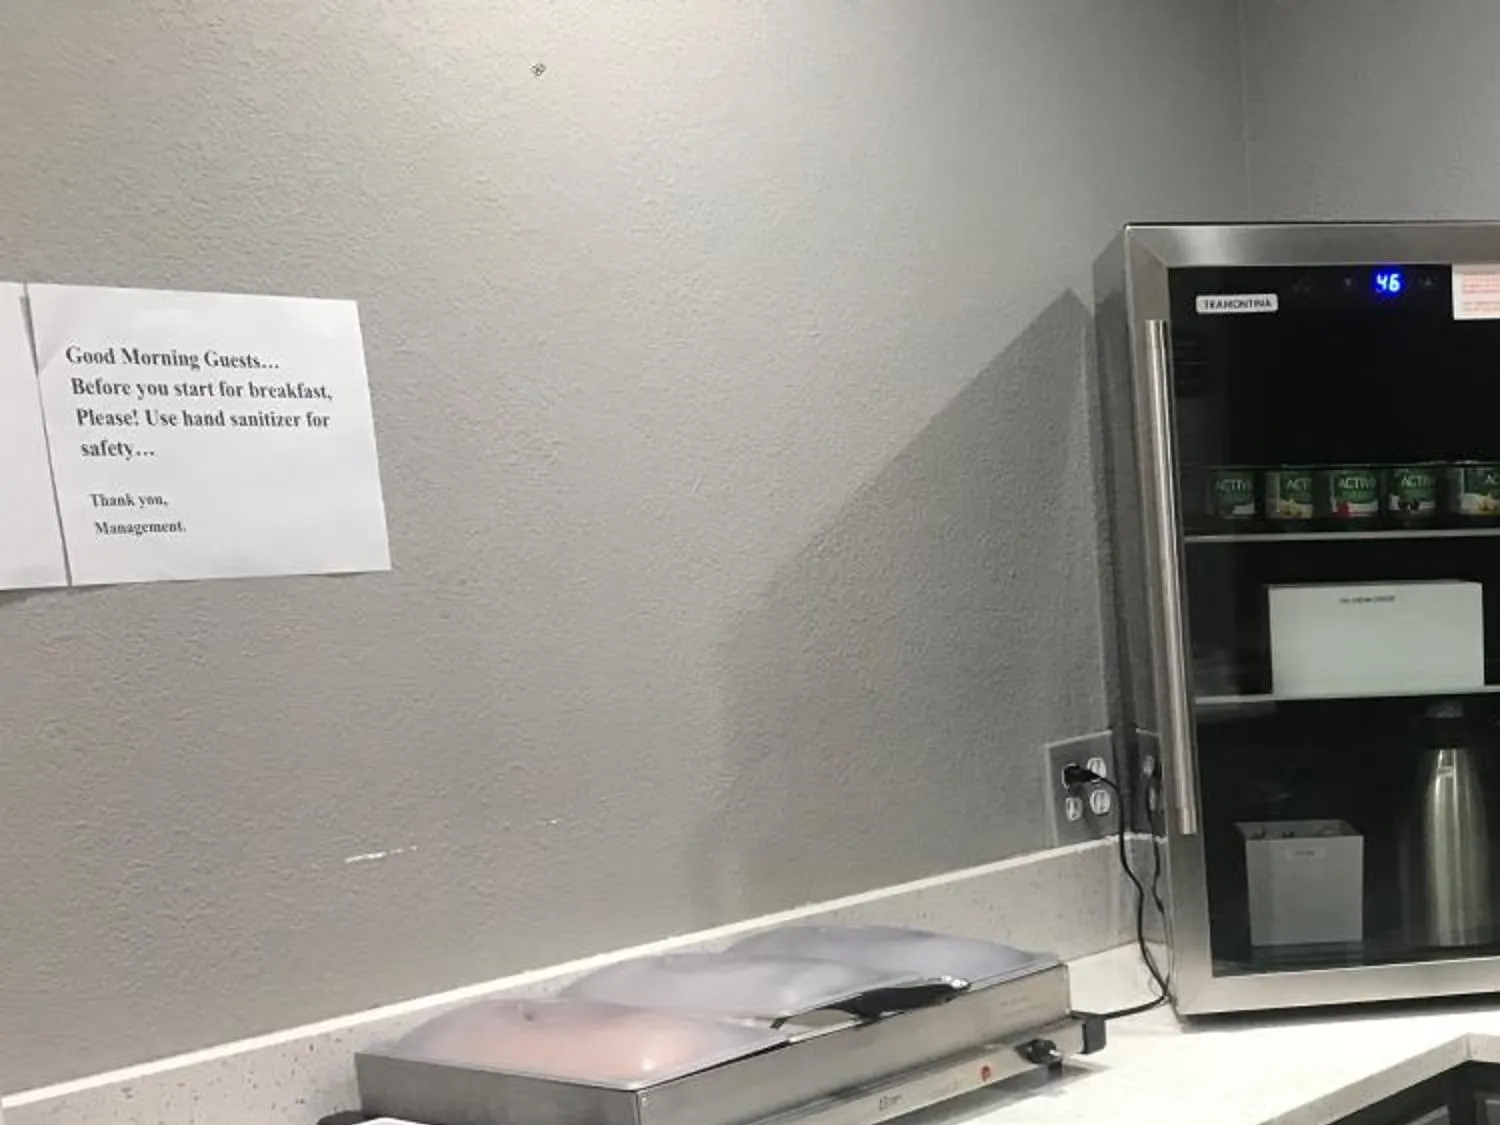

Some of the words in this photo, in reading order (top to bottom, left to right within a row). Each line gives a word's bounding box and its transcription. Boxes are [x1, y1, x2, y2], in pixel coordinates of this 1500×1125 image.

[1376, 272, 1400, 293] 46
[65, 346, 116, 365] Good
[121, 347, 200, 369] Morning
[204, 350, 279, 369] Guests...
[71, 377, 131, 395] Before
[137, 384, 168, 400] you
[174, 381, 214, 397] start
[219, 381, 244, 397] for
[248, 381, 334, 400] breakfast,
[76, 408, 139, 427] Please!
[145, 409, 177, 427] Use
[182, 409, 225, 427] hand
[230, 410, 301, 427] sanitizer
[306, 411, 331, 427] for
[81, 439, 156, 460] safety...
[90, 493, 135, 507] Thank
[138, 495, 168, 509] you,
[95, 521, 187, 536] Management.
